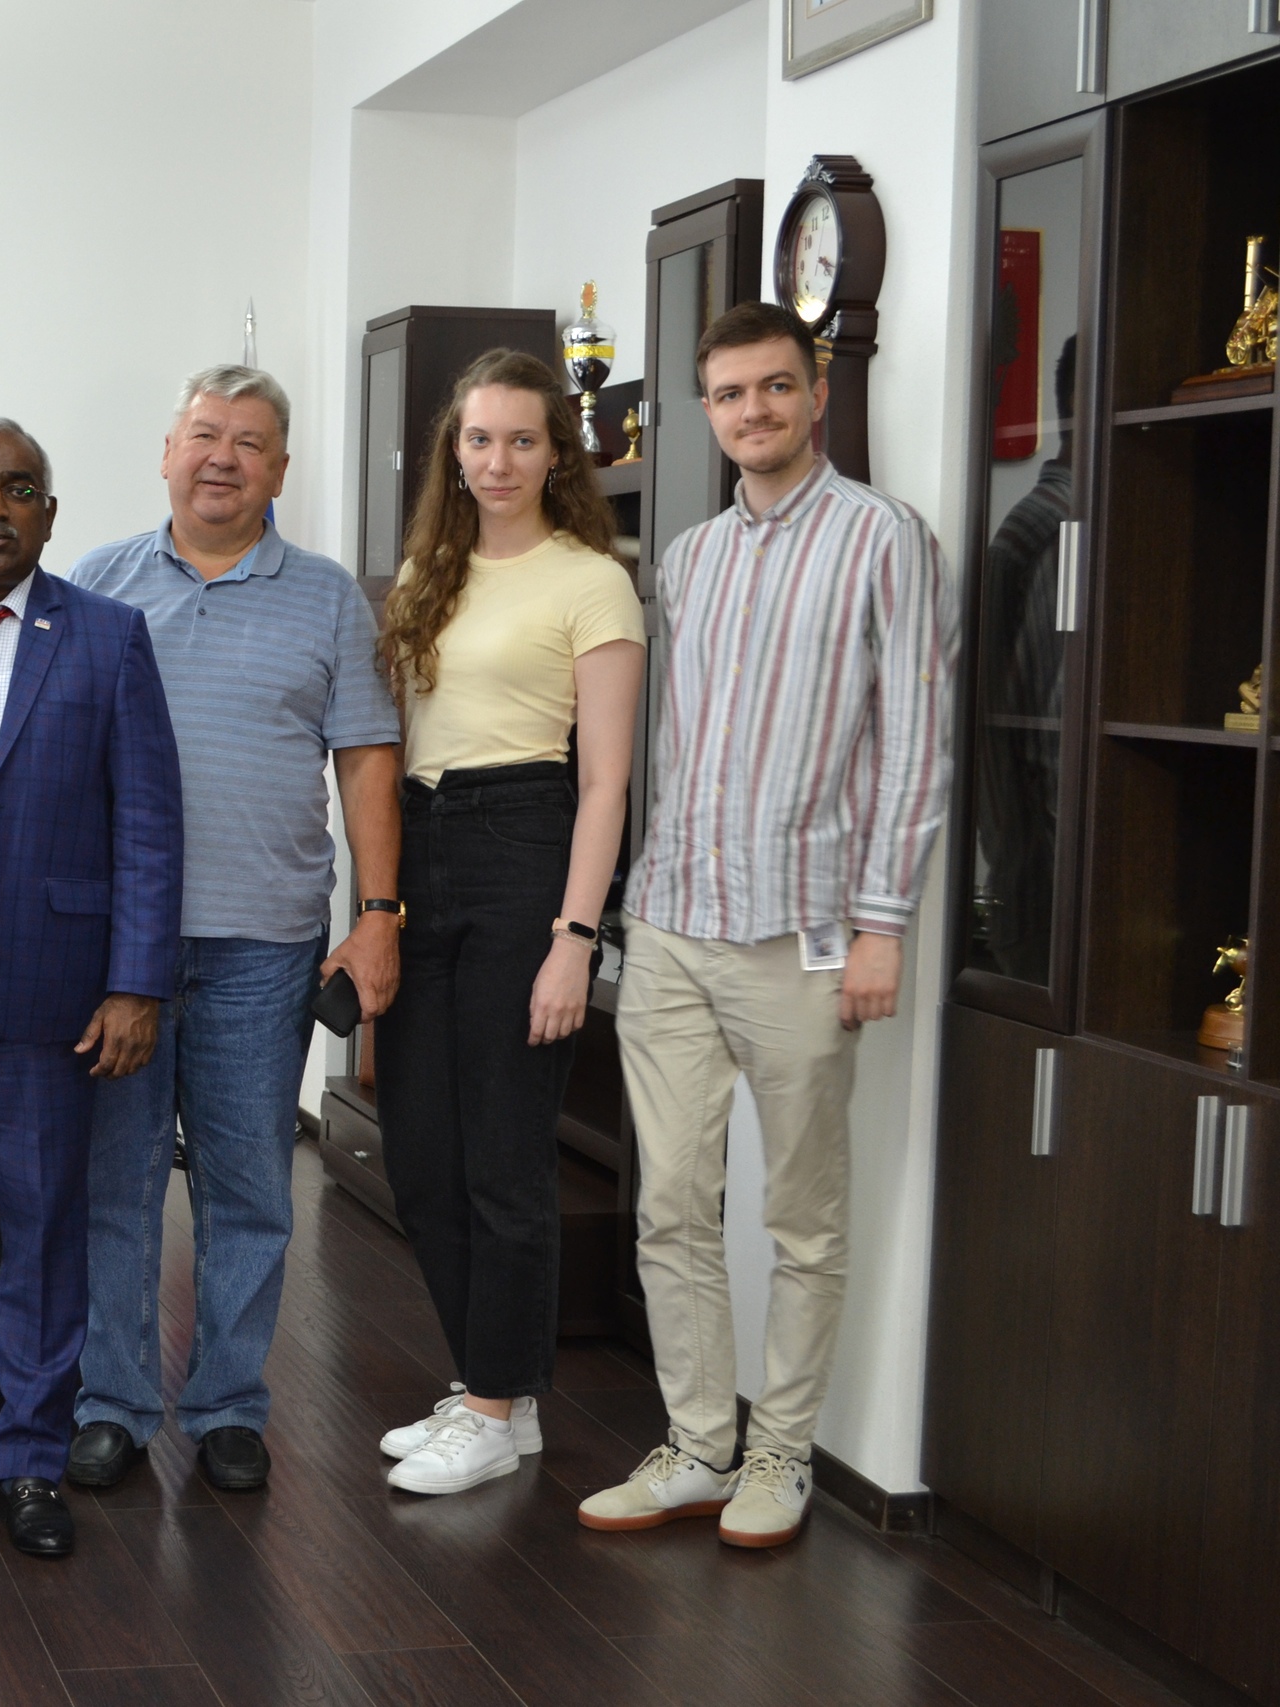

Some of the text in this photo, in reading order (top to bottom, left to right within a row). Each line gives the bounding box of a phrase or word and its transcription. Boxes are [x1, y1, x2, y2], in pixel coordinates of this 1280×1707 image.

[822, 206, 830, 221] 12
[812, 217, 818, 232] 11
[805, 235, 812, 250] 10
[800, 260, 805, 275] 9
